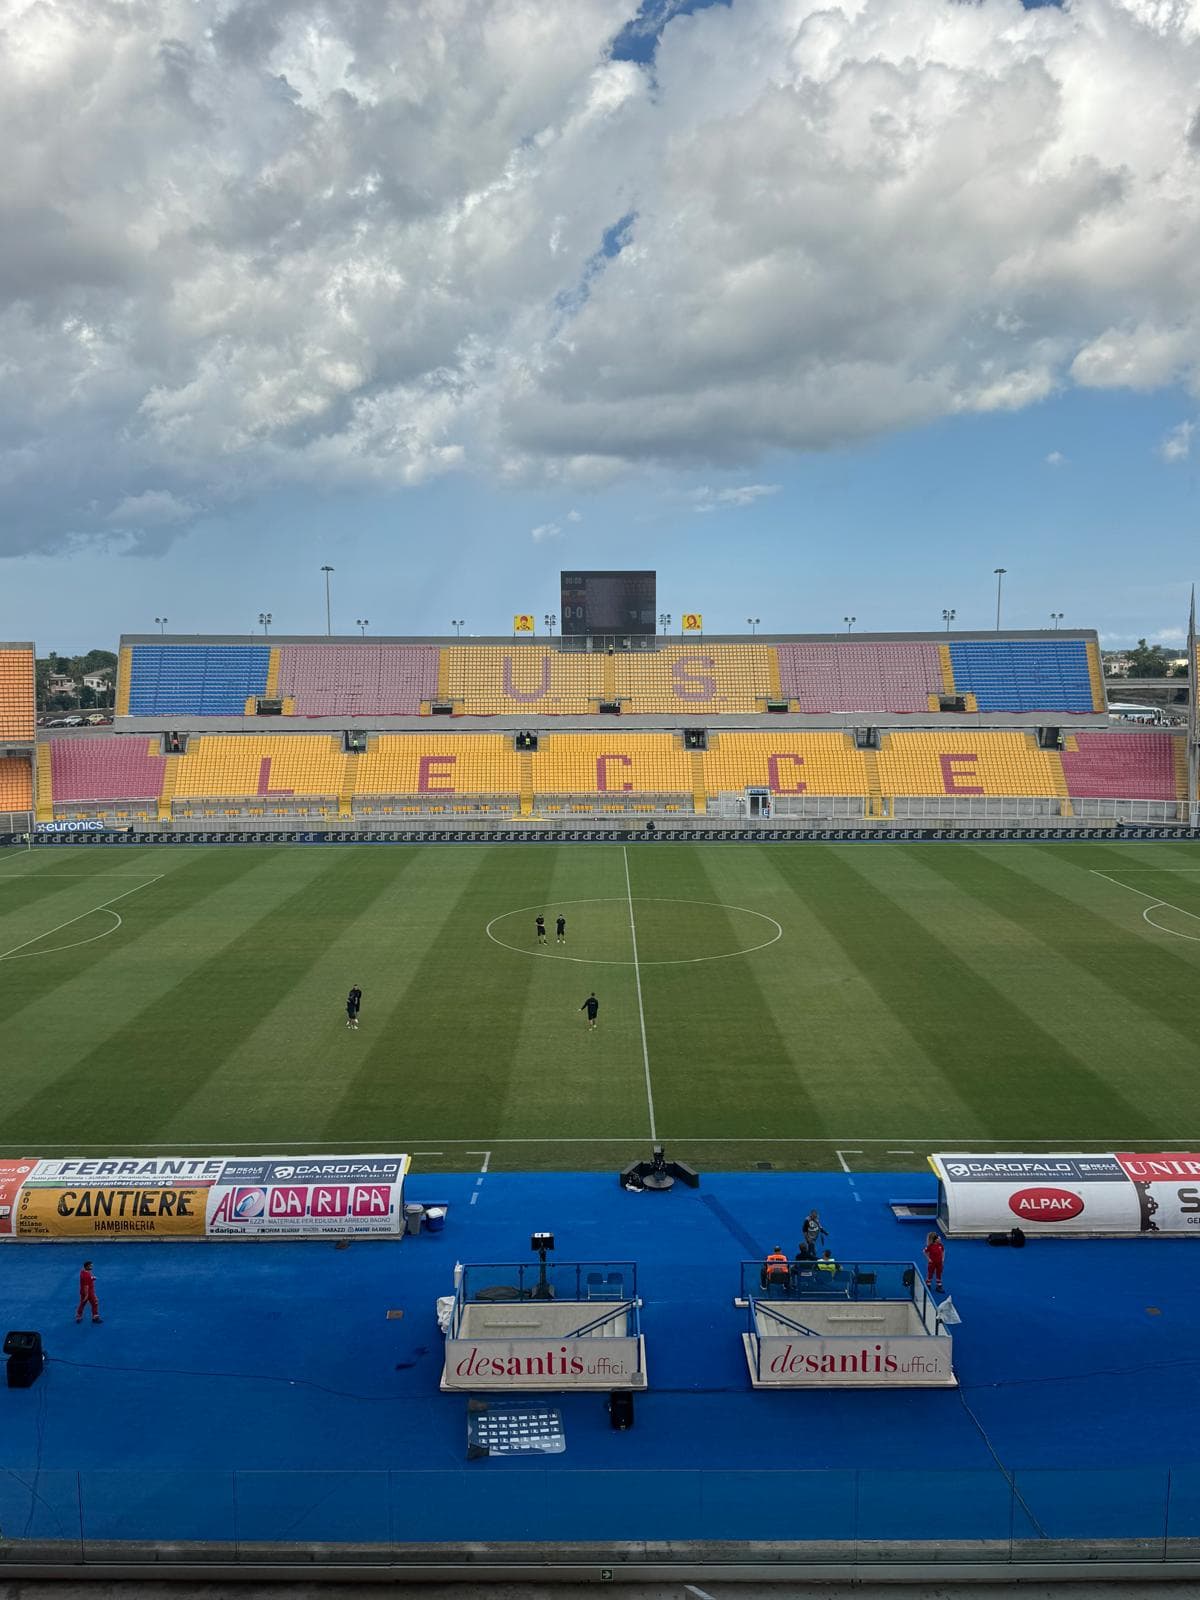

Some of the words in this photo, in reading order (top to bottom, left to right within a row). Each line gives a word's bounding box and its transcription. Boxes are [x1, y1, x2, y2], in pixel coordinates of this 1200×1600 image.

[46, 820, 104, 832] euronics
[58, 1160, 224, 1175] FERRANTE
[57, 1190, 194, 1217] CANTIERE
[1019, 1198, 1073, 1210] ALPAK
[94, 1220, 156, 1233] HAMBIRRERIA
[456, 1347, 584, 1376] desantis
[770, 1344, 898, 1373] desantis
